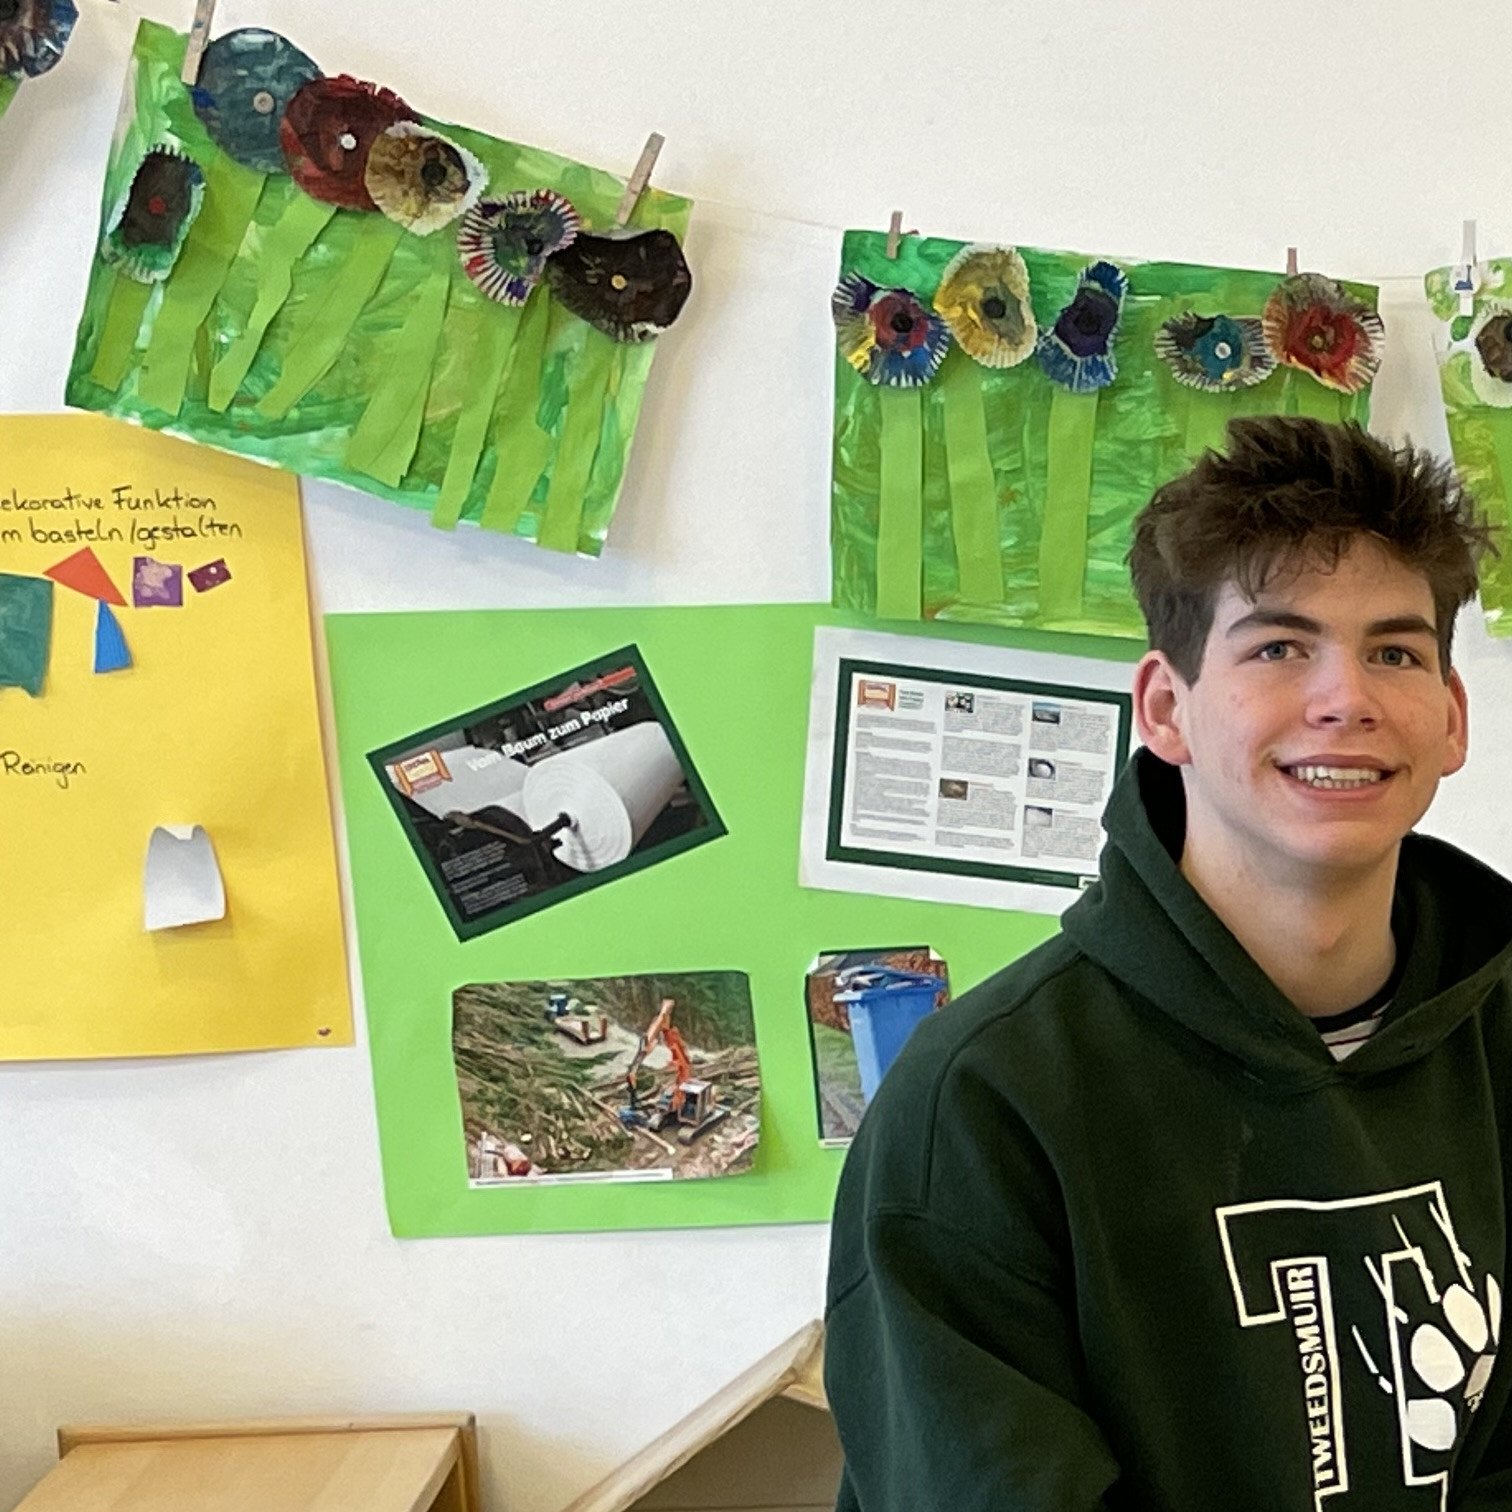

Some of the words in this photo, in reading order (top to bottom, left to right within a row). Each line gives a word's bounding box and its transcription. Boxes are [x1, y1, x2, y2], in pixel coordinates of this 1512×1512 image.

[0, 486, 104, 511] ekorative
[112, 485, 217, 511] Funktion
[466, 752, 502, 772] Vom
[501, 732, 548, 758] Baum
[547, 718, 581, 741] zum
[580, 698, 629, 726] Papier
[1286, 1265, 1336, 1490] TWEEDSMUIR
